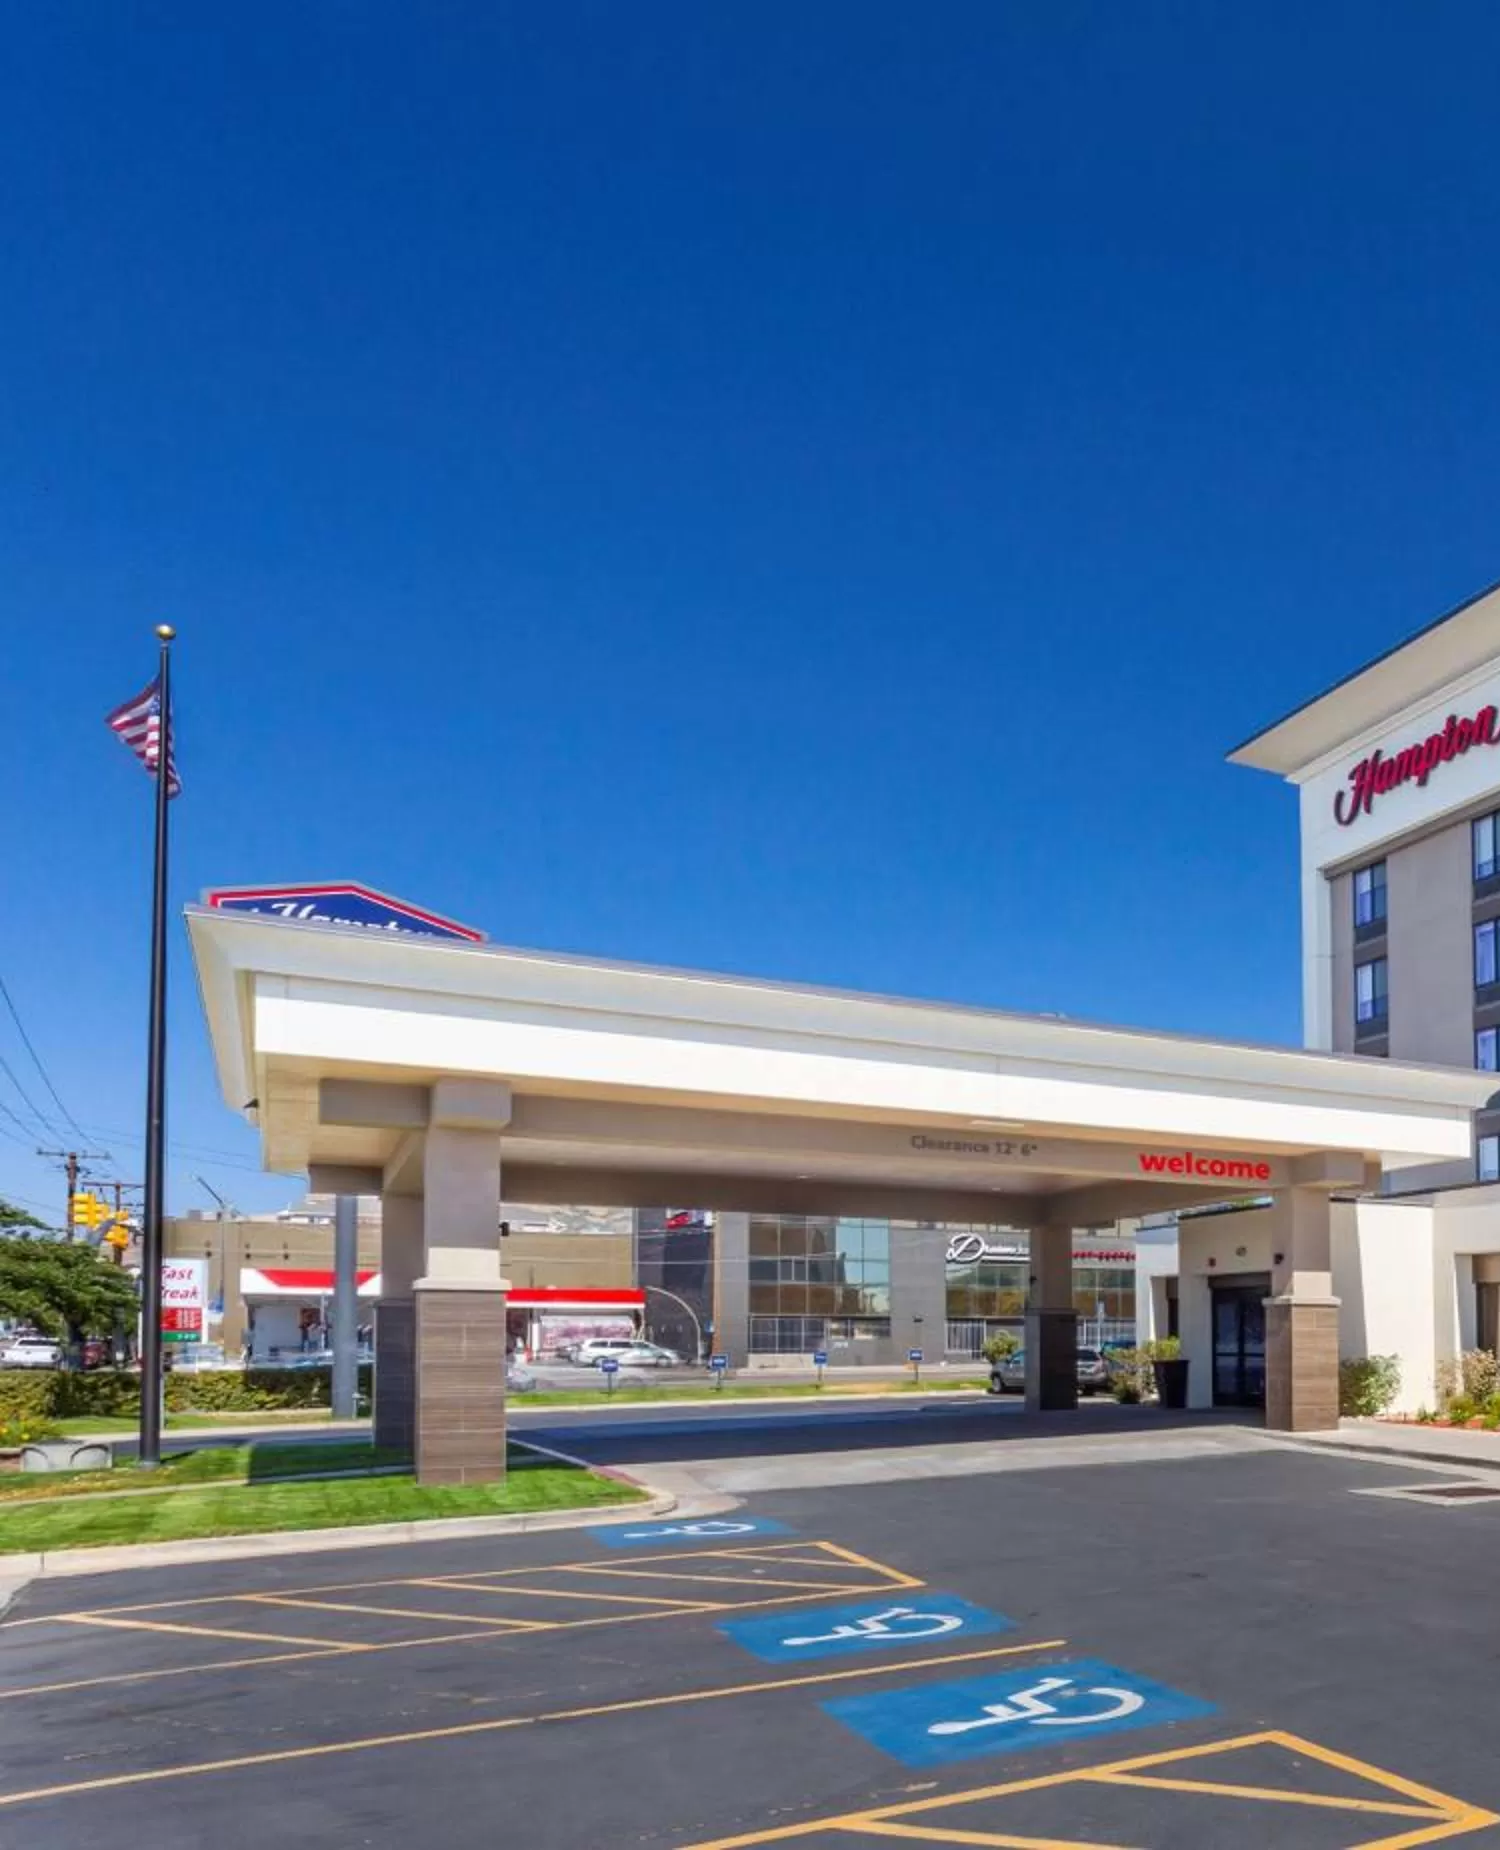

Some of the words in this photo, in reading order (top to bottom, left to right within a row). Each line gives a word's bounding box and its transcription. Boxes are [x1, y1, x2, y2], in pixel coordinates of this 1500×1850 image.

[910, 1135, 990, 1153] Clearance
[1139, 1151, 1271, 1181] welcome
[161, 1285, 199, 1299] reak
